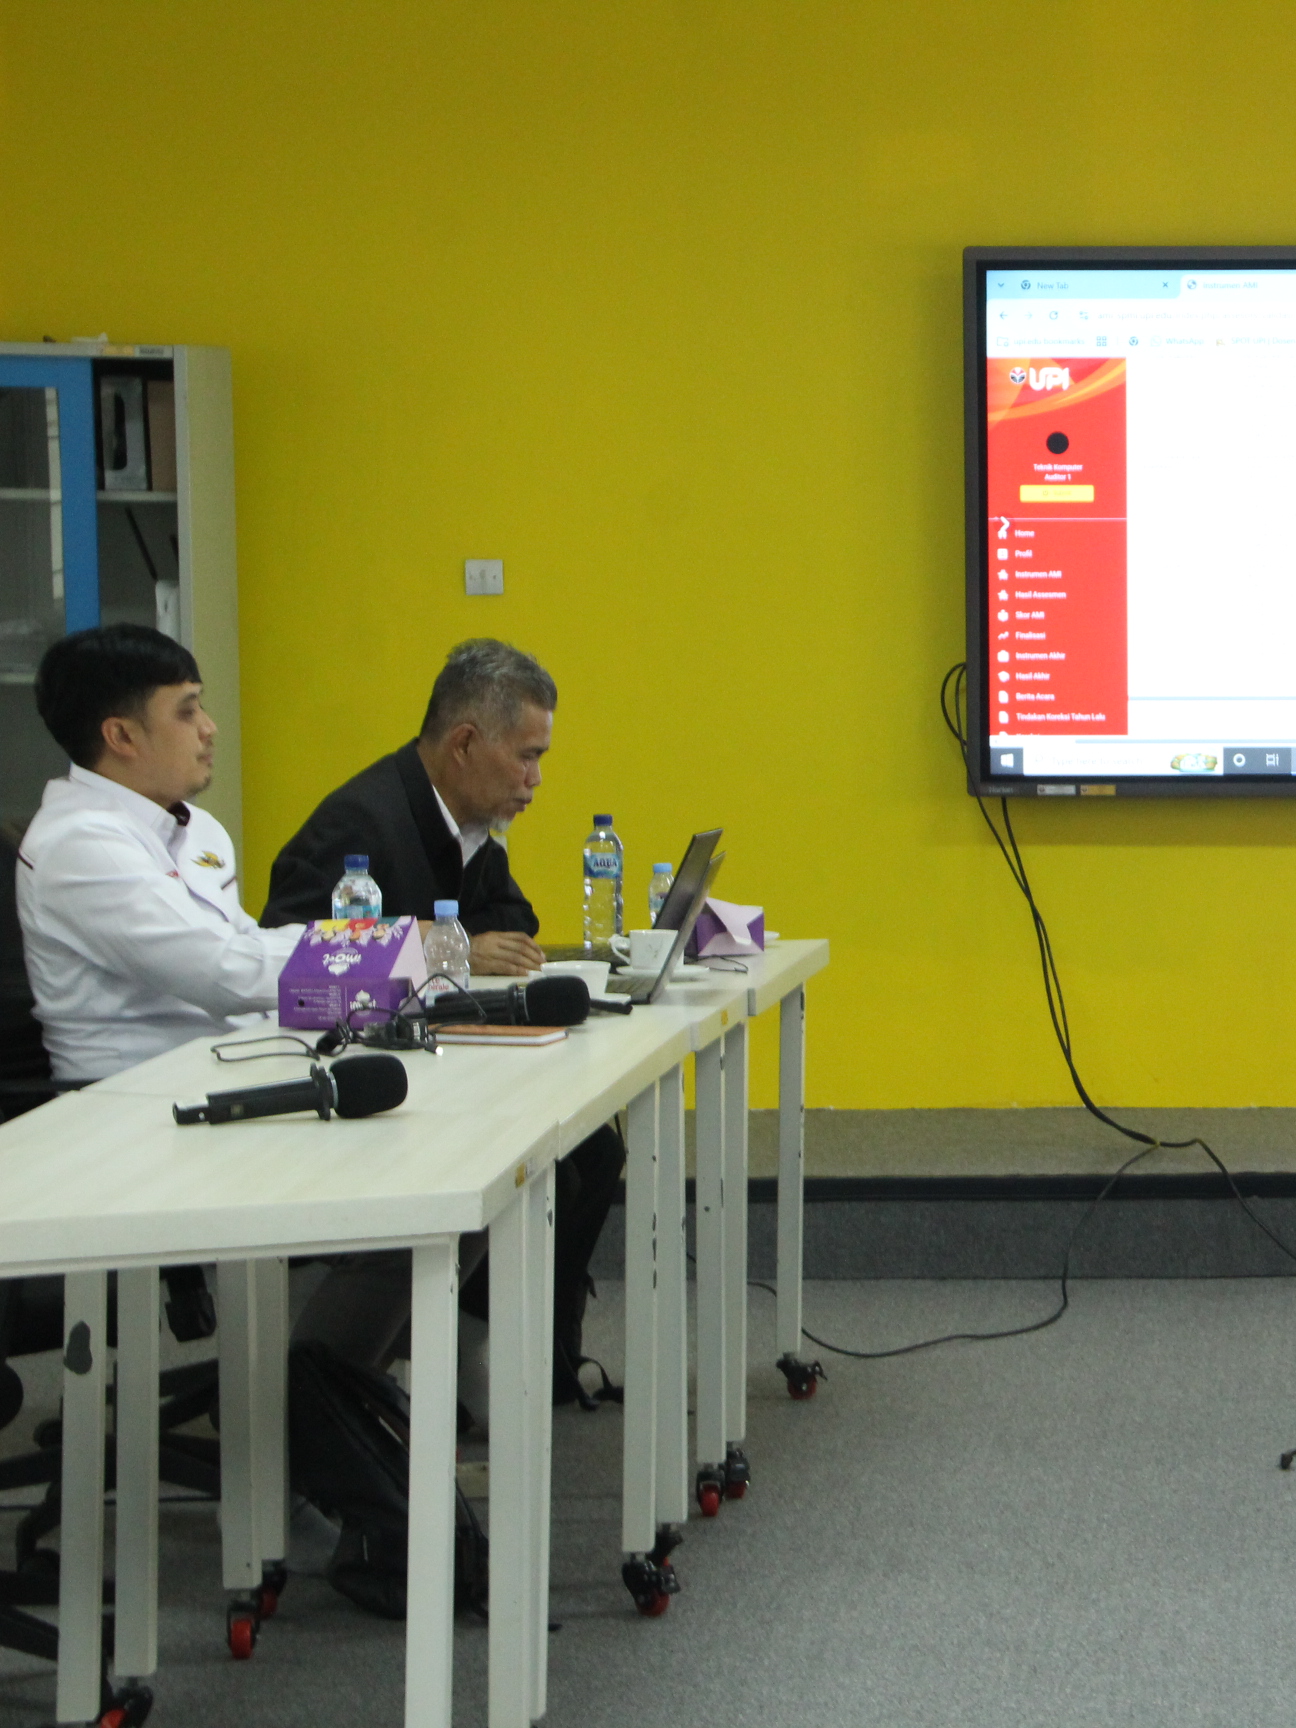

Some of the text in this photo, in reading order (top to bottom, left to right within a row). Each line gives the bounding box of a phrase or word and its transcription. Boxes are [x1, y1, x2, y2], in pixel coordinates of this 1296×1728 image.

[1037, 282, 1069, 290] New Tab
[1243, 281, 1258, 289] AMI
[1043, 337, 1085, 345] bookmarks
[1165, 337, 1205, 346] WhatsApp
[1029, 367, 1070, 391] UPI
[1033, 463, 1083, 473] Teknik Komputer
[1044, 473, 1067, 481] Auditor
[1014, 529, 1035, 538] Home
[1014, 549, 1033, 558] Profil
[1015, 570, 1063, 579] Instrumen AMI
[1015, 591, 1067, 600] Hasil Assesmen
[1015, 611, 1046, 620] Skor AMI
[1015, 631, 1047, 640] Finalisasi
[1015, 652, 1067, 661] Instrumen Akhir
[1015, 672, 1051, 681] Hasil Akhir
[1015, 692, 1055, 701] Berita Acara
[1016, 712, 1106, 722] Tindakan Koreksi Tahun Lalu
[593, 857, 618, 869] AQUA
